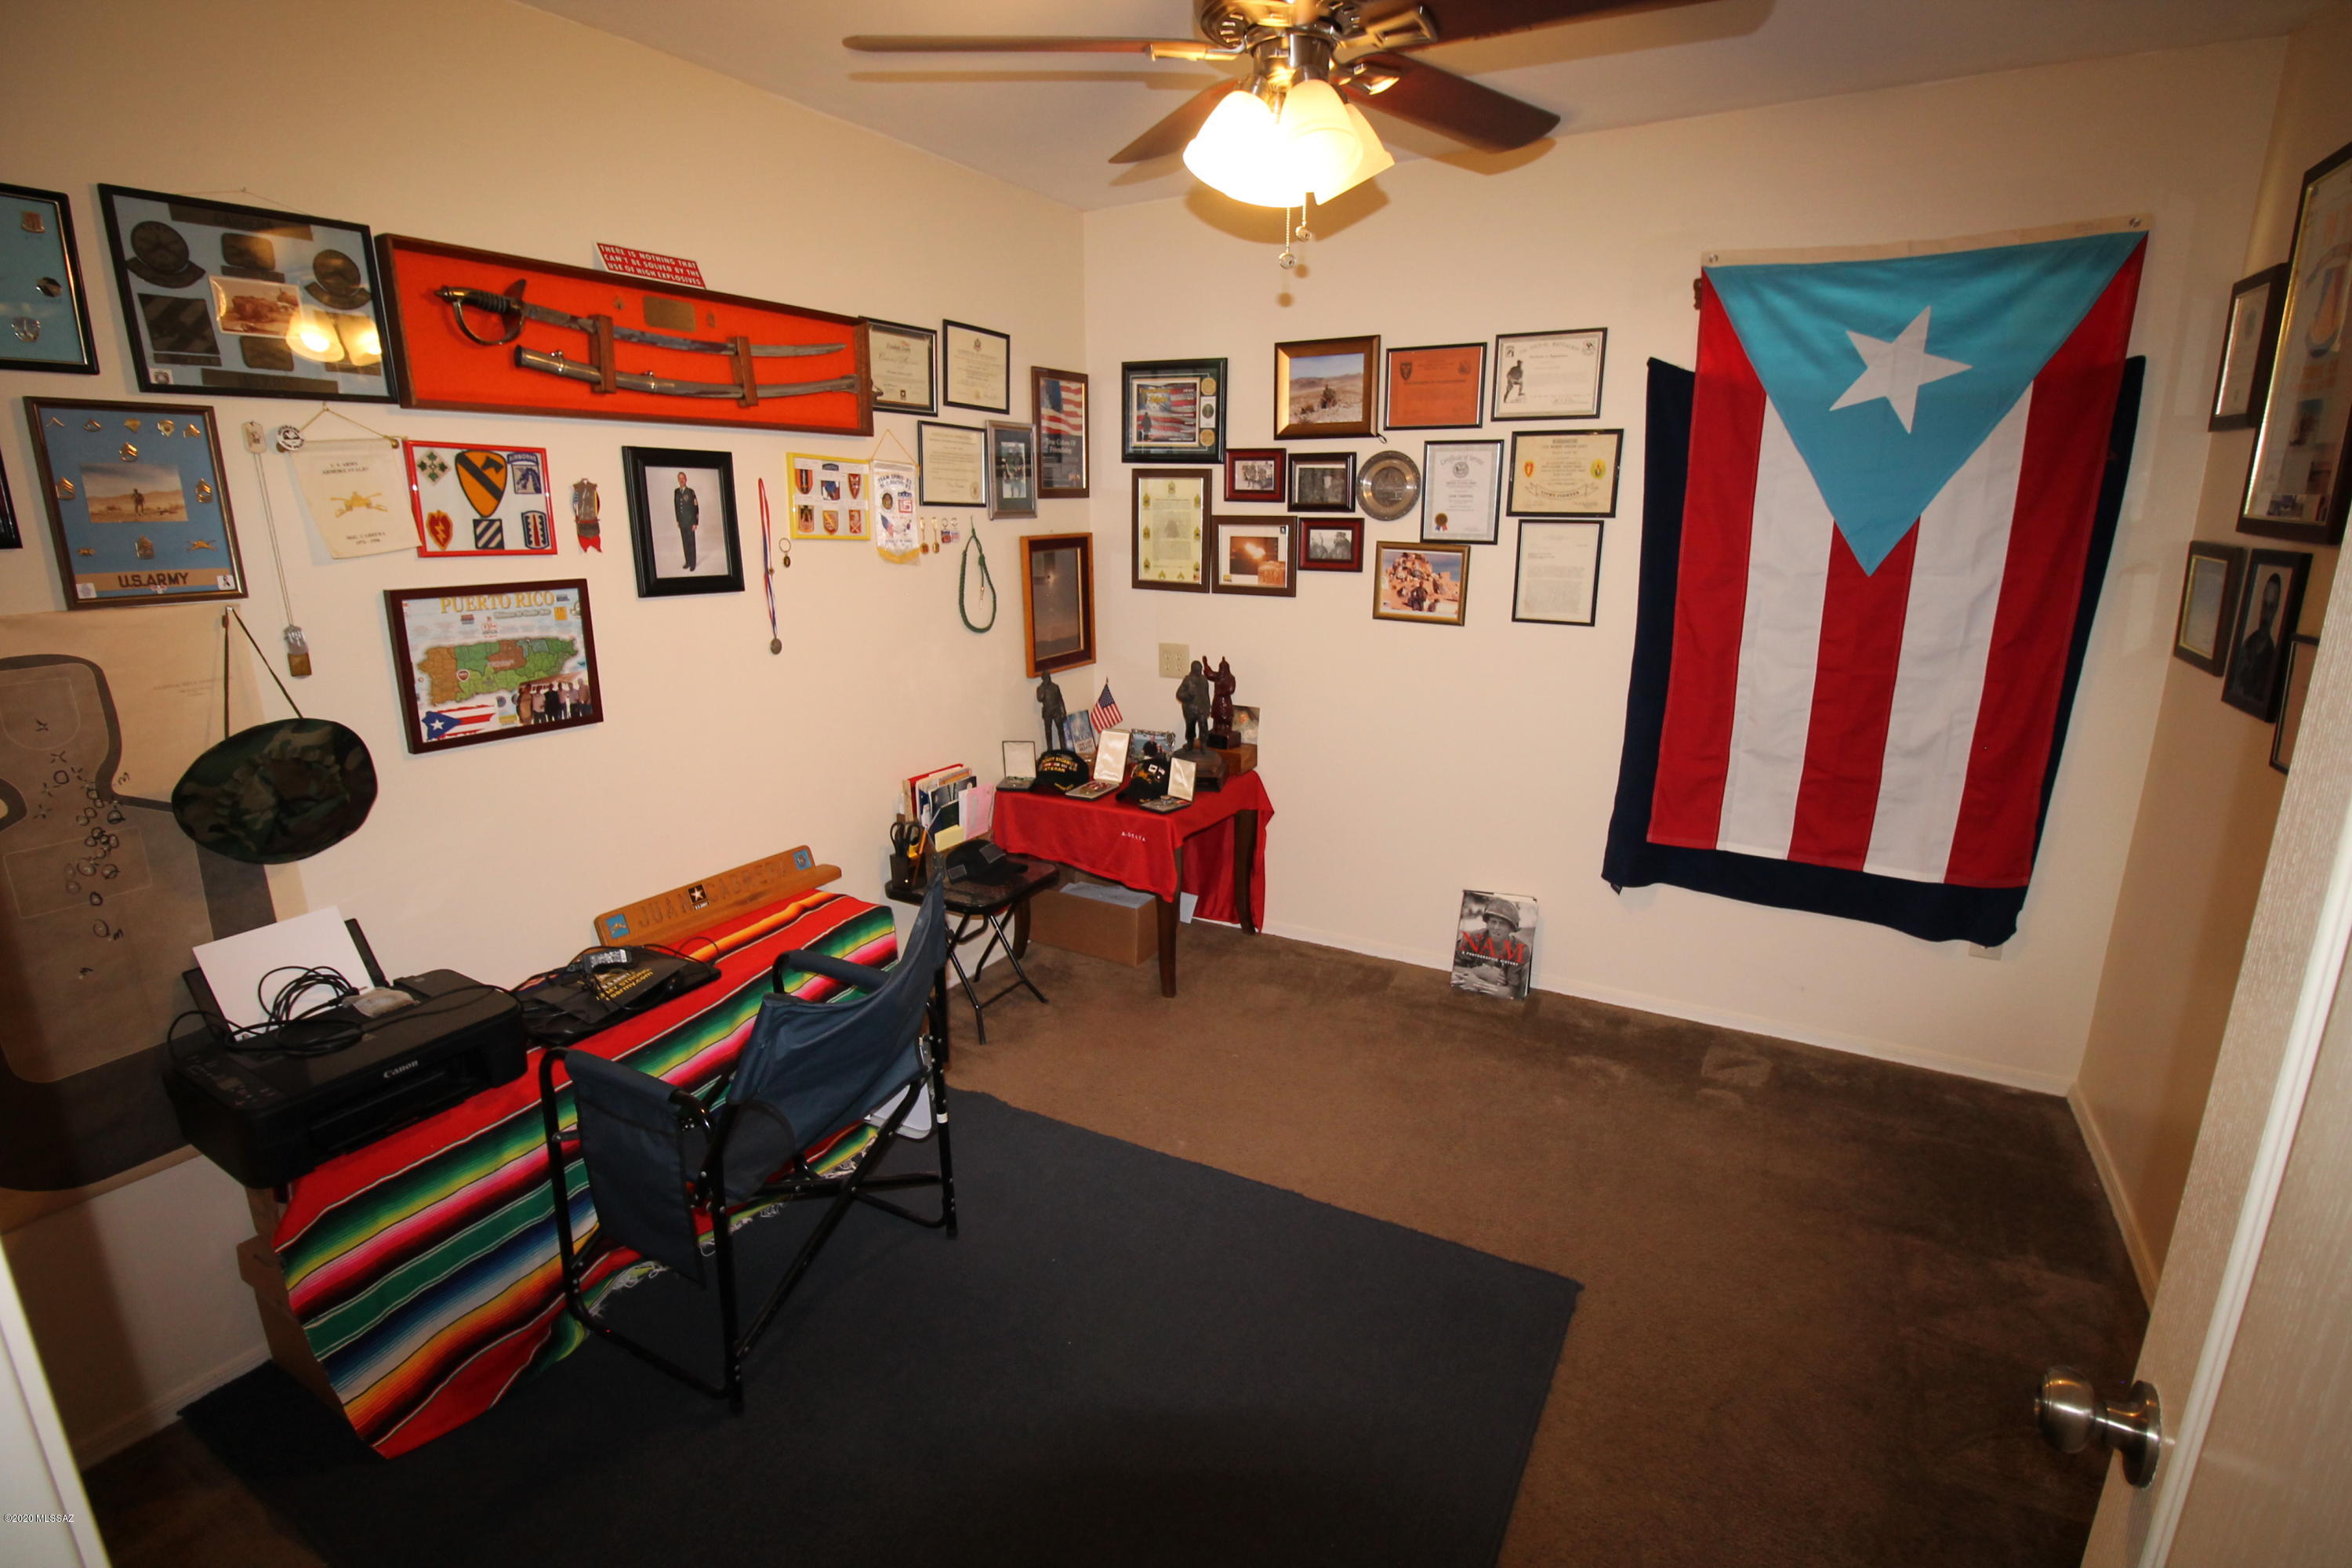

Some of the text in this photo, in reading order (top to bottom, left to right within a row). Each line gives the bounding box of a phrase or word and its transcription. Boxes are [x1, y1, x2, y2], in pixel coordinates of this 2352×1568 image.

[601, 245, 625, 256] THERE
[639, 252, 675, 265] NOTHING
[678, 260, 696, 269] THAT
[604, 254, 628, 264] CAN'T
[643, 261, 672, 272] SOLVED
[687, 269, 700, 278] THE
[608, 263, 624, 271] USE
[636, 267, 657, 278] HIGH
[439, 594, 511, 614] PUERTO
[515, 590, 555, 608] RICO
[1458, 931, 1527, 964] NAM
[1466, 951, 1498, 962] PHOTOGRAPHIC
[383, 1060, 418, 1078] Canon
